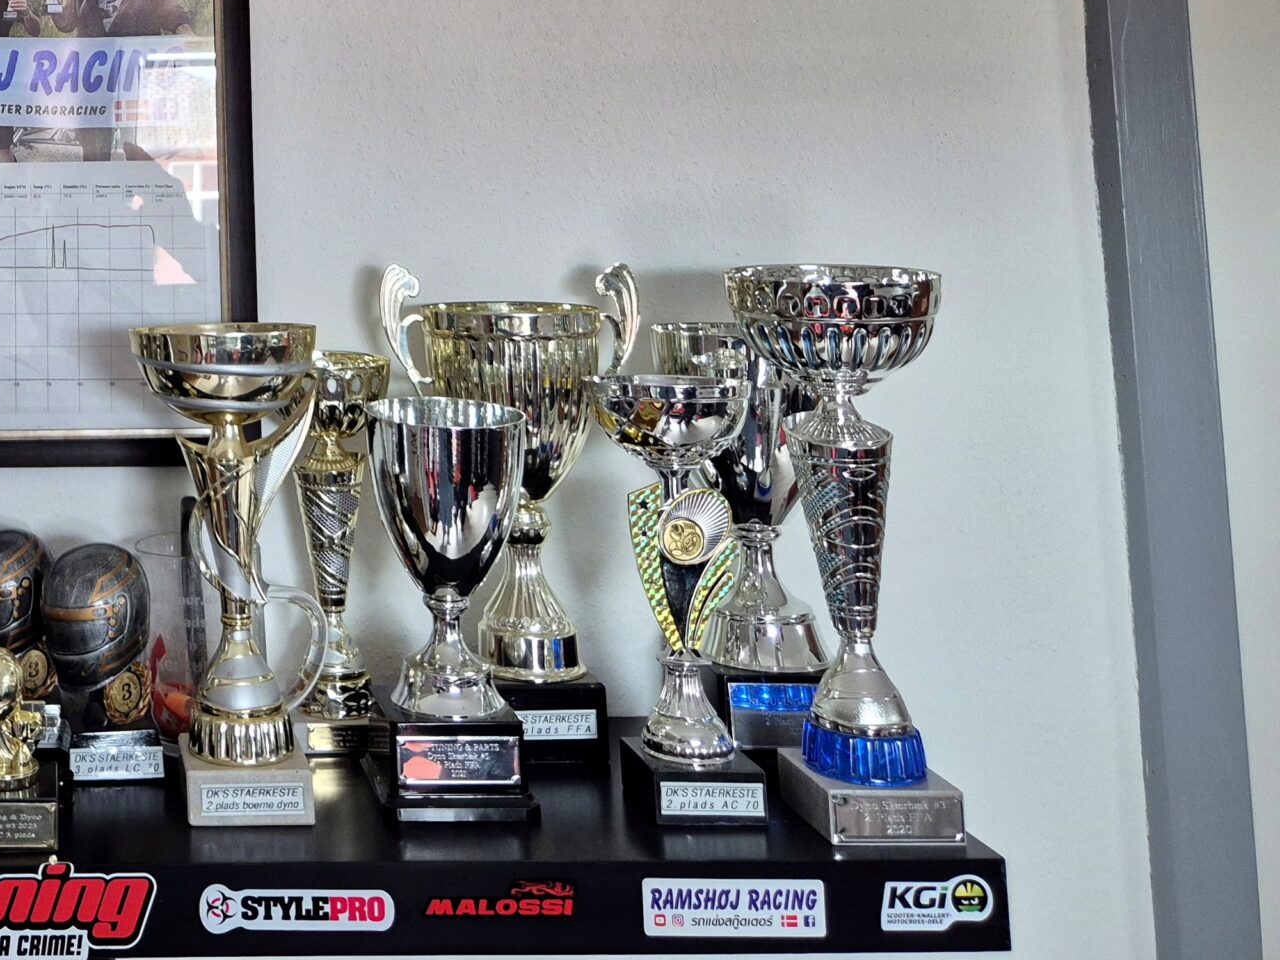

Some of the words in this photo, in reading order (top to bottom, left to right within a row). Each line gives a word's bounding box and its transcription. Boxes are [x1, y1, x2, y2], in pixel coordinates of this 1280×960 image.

[25, 104, 107, 116] DRAGRACING
[121, 683, 132, 700] 3
[530, 715, 592, 724] STAERKESTE
[567, 724, 592, 733] FFA
[473, 743, 500, 751] PARTS
[74, 753, 96, 763] DK'S
[98, 751, 158, 762] STAERKESTE
[125, 764, 141, 772] LC
[206, 788, 229, 799] DK'S
[231, 787, 299, 798] STAERKESTE
[666, 787, 689, 797] DK'S
[691, 788, 759, 798] STAERKESTE
[207, 801, 213, 811] 2
[215, 801, 240, 812] plads
[276, 800, 300, 811] dyno
[721, 800, 739, 809] AC
[745, 800, 759, 810] 70
[649, 887, 741, 912] RAMSHØJ
[747, 888, 818, 912] RACING
[240, 895, 386, 922] STYLEPRO
[425, 897, 574, 917] MALOSSI
[16, 934, 84, 957] CRIME!
